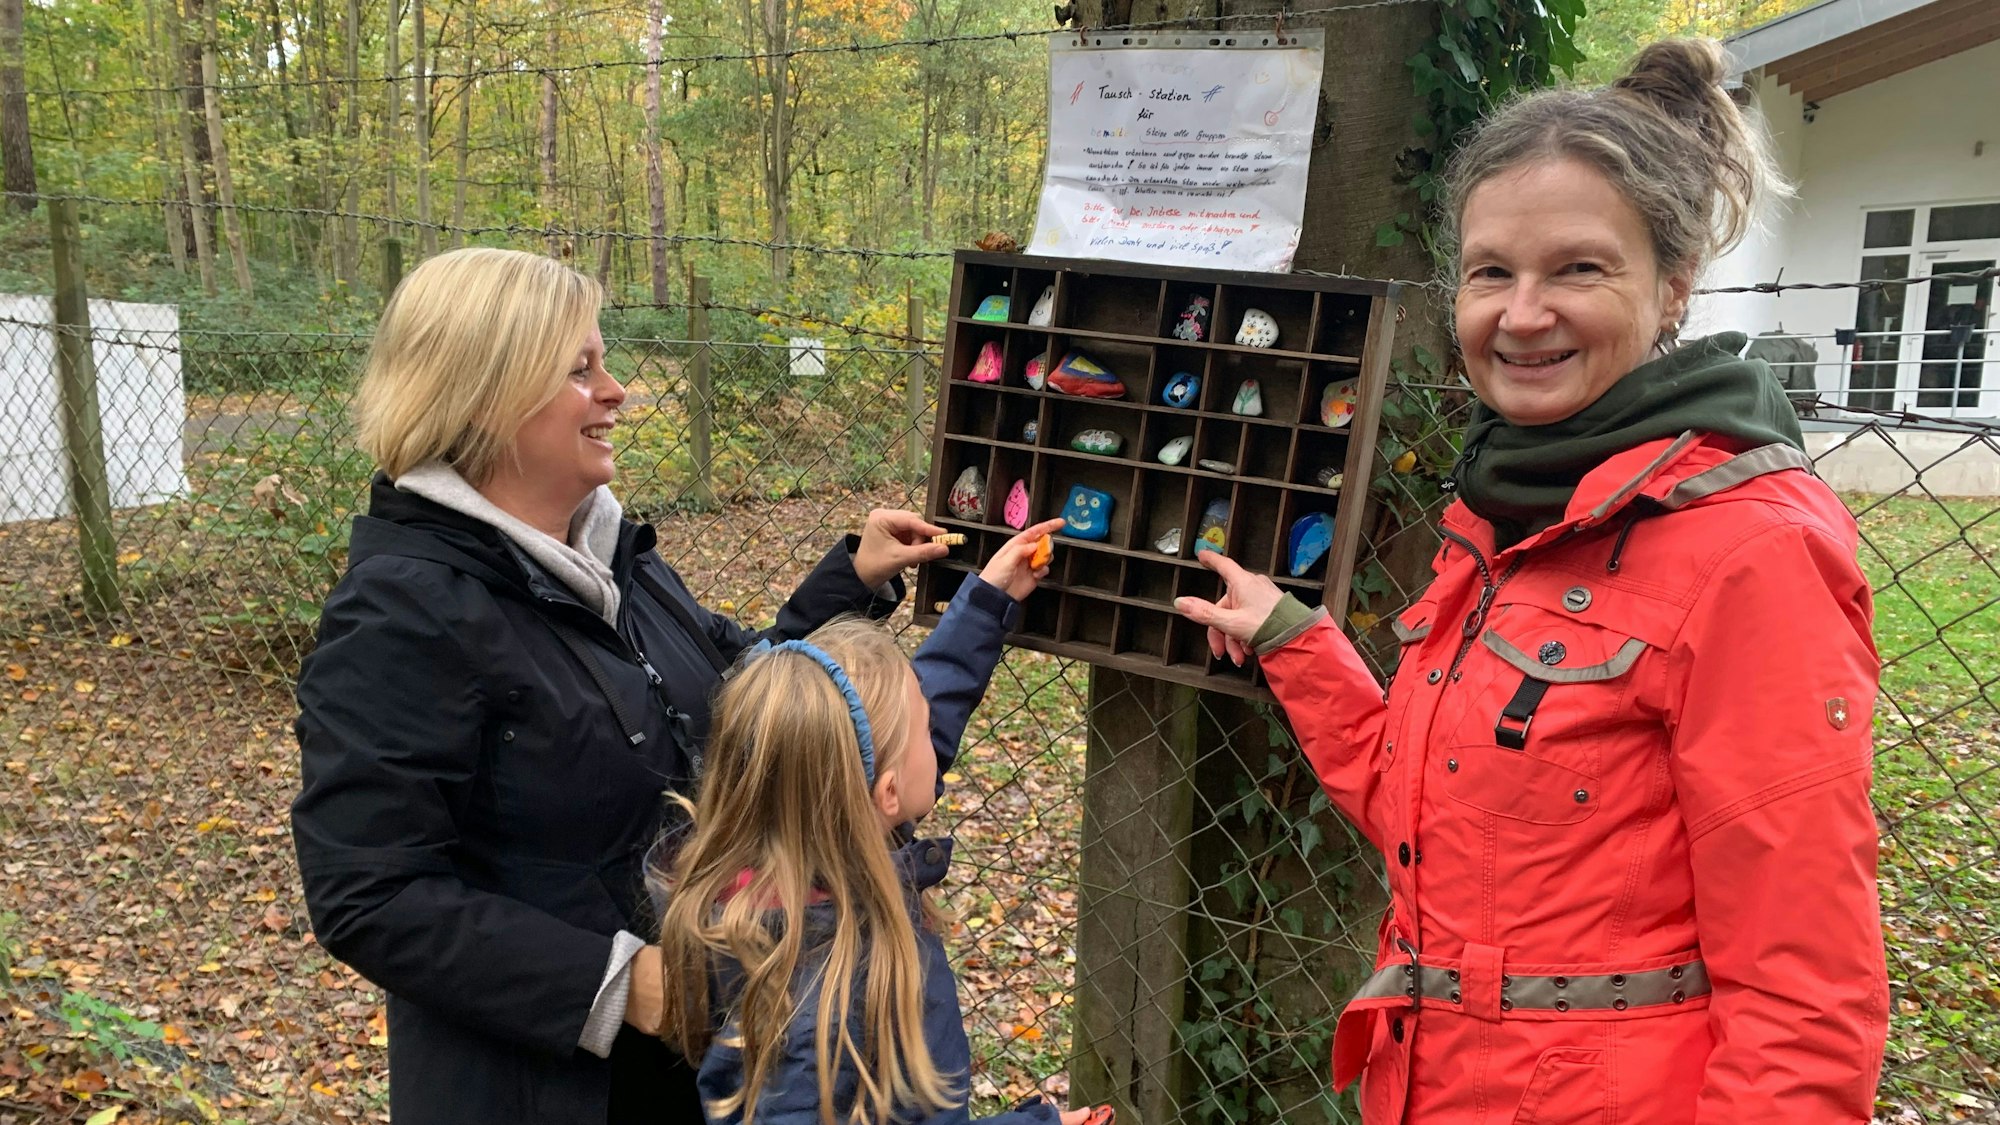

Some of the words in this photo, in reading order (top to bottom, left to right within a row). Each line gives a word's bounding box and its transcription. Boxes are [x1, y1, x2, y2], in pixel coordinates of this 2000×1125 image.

[1098, 84, 1133, 99] Tausch
[1136, 107, 1154, 122] für
[1145, 128, 1167, 138] Steine
[1195, 130, 1226, 142] Gruppen
[1083, 202, 1105, 212] Bitte
[1129, 205, 1143, 217] bei
[1239, 208, 1261, 219] und
[1179, 222, 1199, 233] oder
[1089, 235, 1114, 247] Vielen
[1118, 235, 1142, 247] Dank
[1146, 240, 1166, 250] und
[1169, 241, 1191, 251] viel
